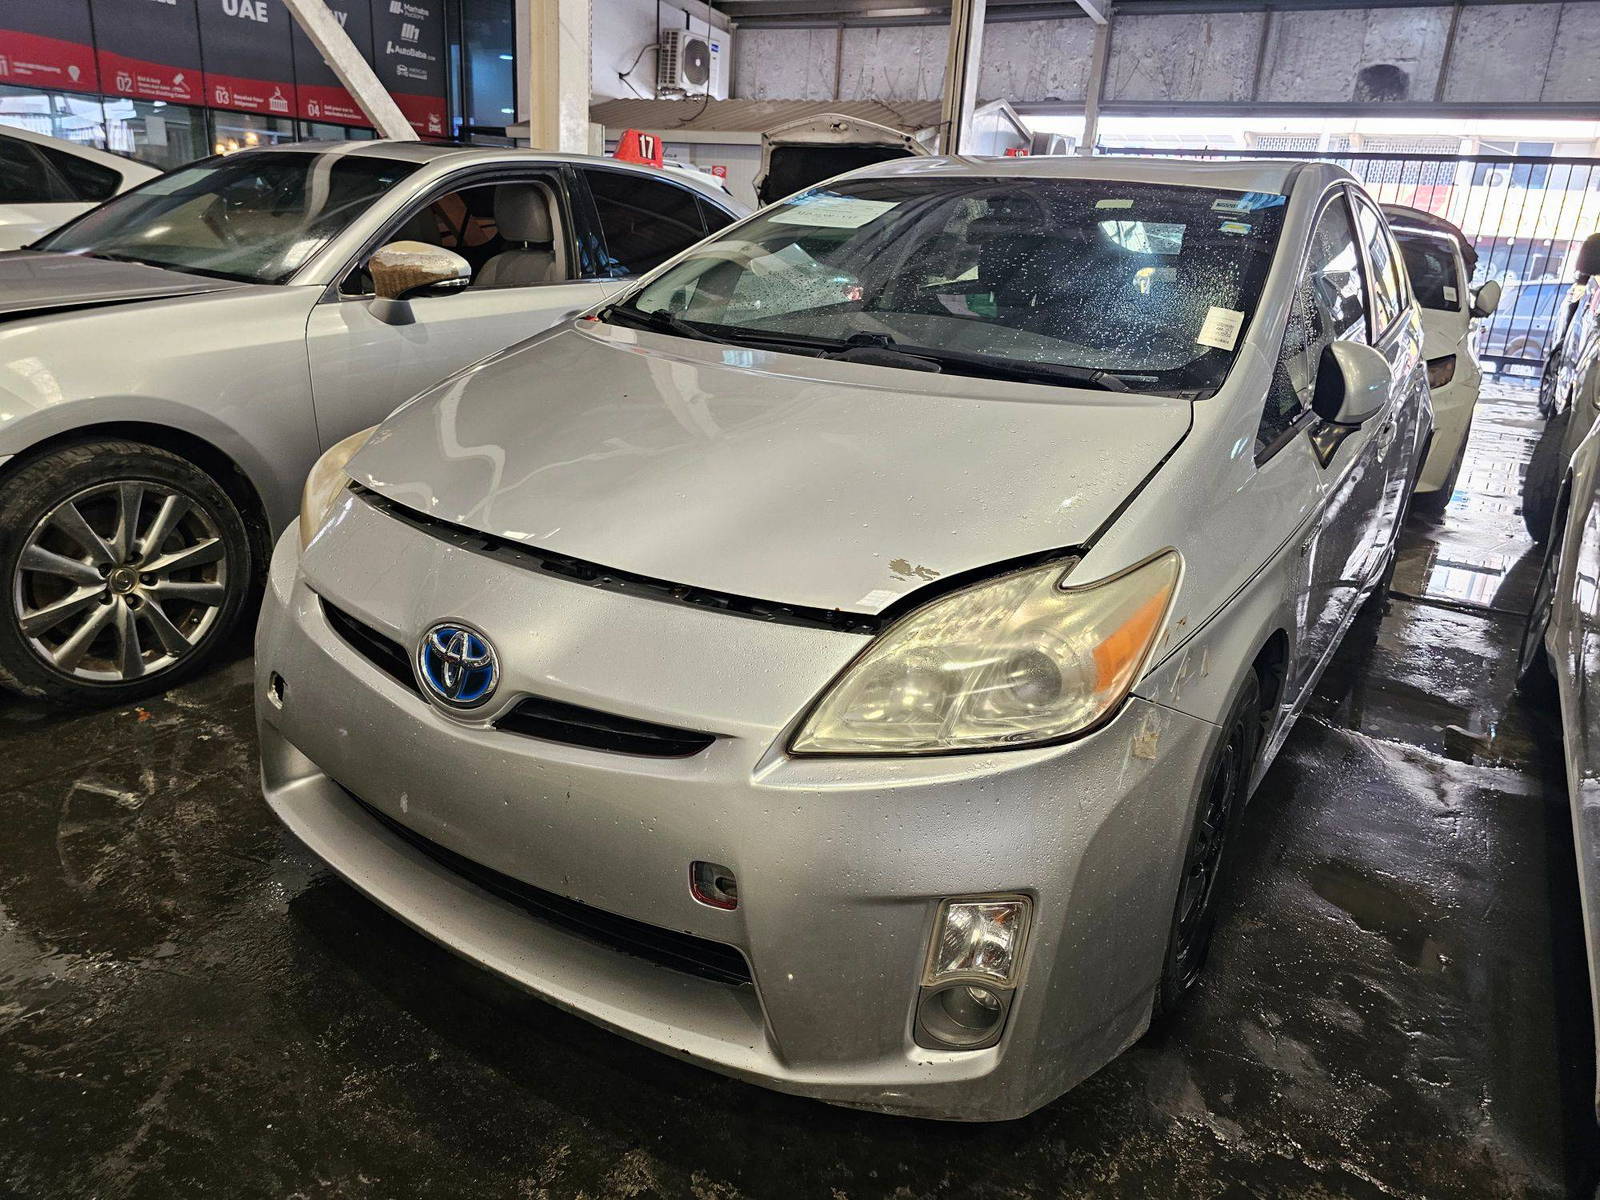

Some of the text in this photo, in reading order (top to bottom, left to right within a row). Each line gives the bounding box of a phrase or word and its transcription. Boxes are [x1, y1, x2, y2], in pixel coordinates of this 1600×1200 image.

[221, 0, 268, 23] UAE
[116, 76, 133, 93] 02
[215, 90, 229, 105] 03
[308, 104, 320, 118] 04
[639, 134, 655, 159] 17
